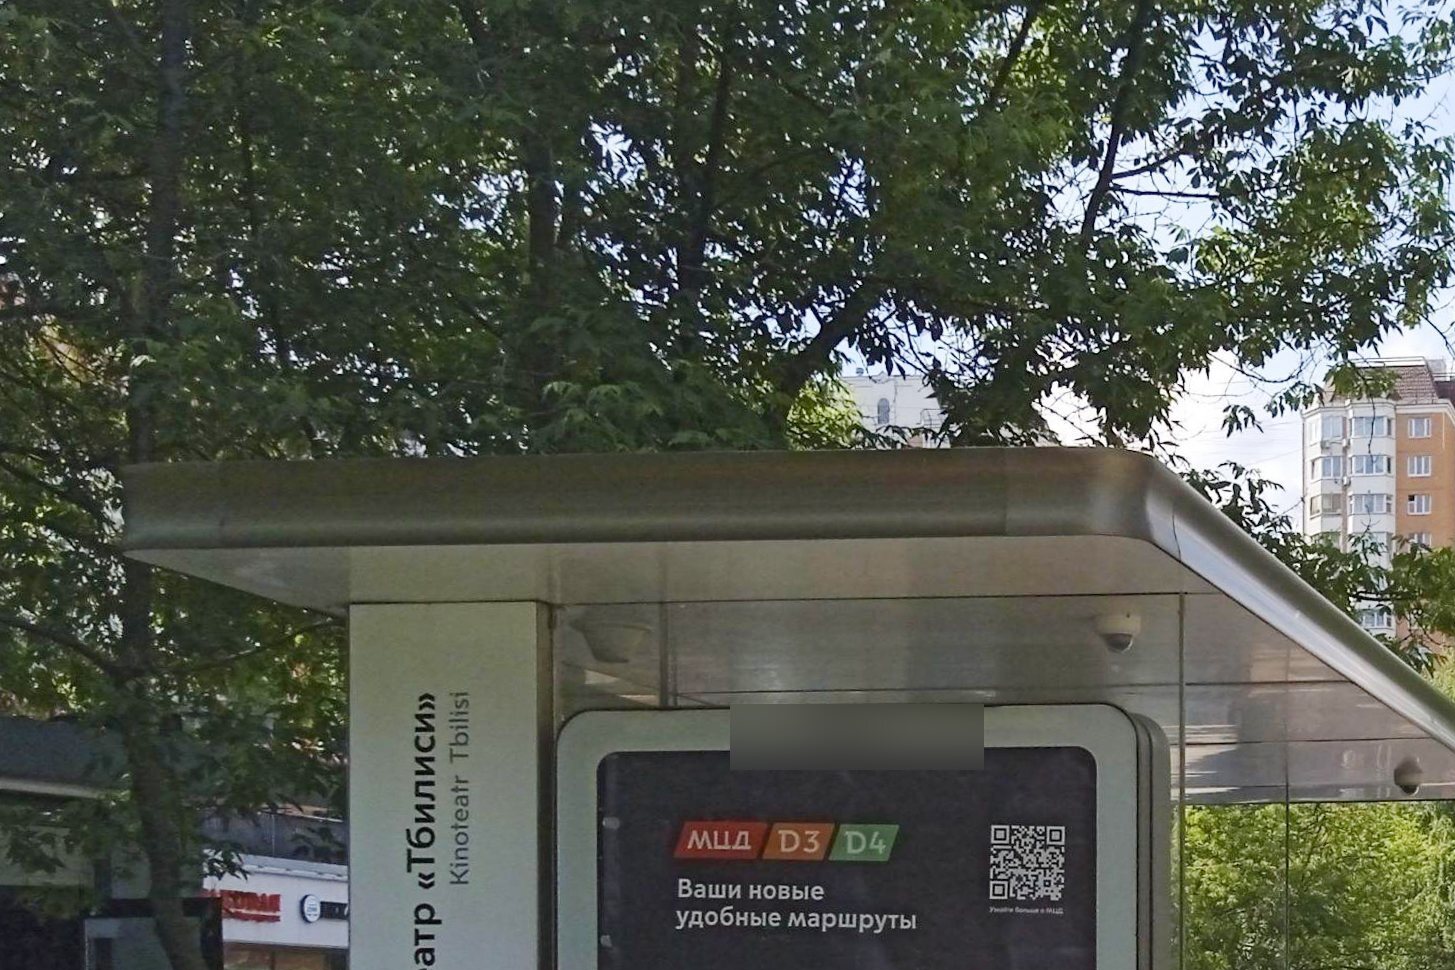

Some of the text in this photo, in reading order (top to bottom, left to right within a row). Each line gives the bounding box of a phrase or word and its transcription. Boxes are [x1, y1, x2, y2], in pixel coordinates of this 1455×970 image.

[406, 693, 436, 890] «Тбилиси»
[449, 691, 470, 885] Kinoteatr Tbilisi
[687, 829, 887, 854] МЦД D3 D4
[678, 878, 825, 900] Ваши новые
[675, 905, 917, 934] удобные маршруты
